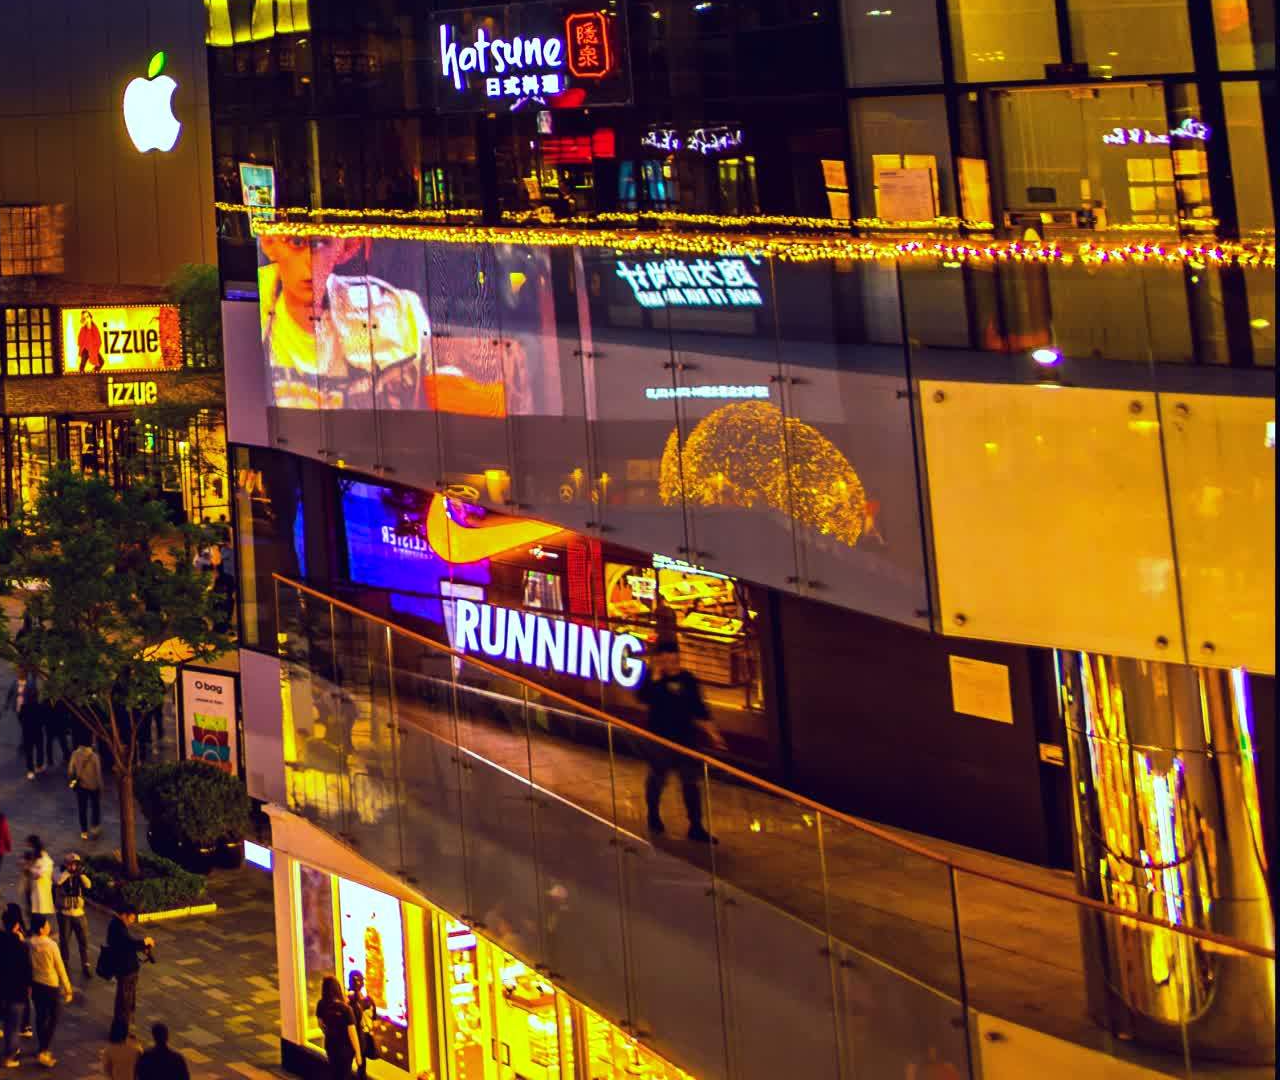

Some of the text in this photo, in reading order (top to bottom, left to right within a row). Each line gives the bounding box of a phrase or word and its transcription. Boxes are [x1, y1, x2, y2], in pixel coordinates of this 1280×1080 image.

[486, 73, 560, 97] 日式料理
[103, 322, 158, 354] izzue
[107, 376, 158, 408] izzue
[456, 599, 644, 688] RUNNING
[194, 680, 223, 695] O bag
